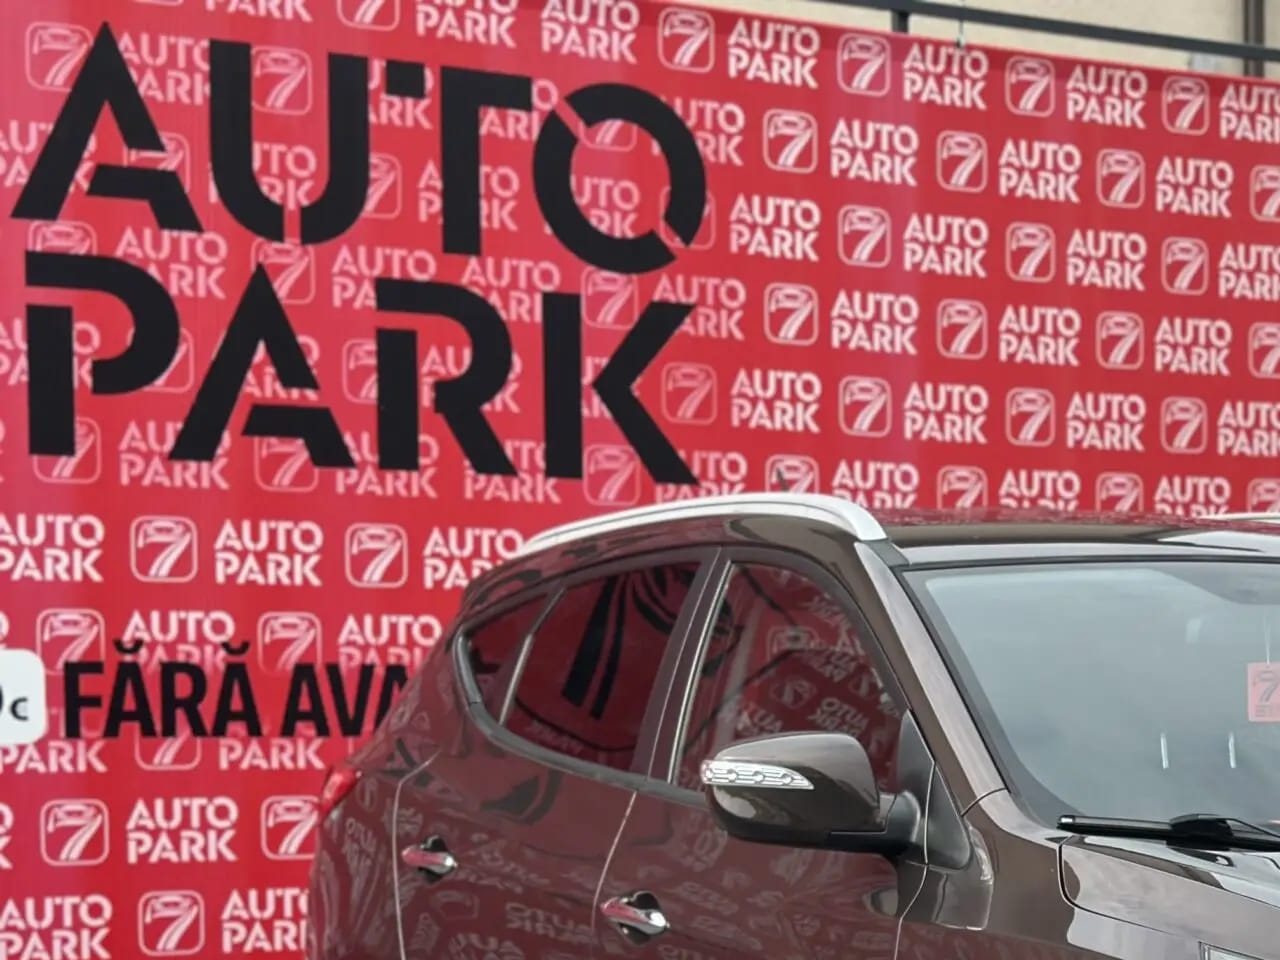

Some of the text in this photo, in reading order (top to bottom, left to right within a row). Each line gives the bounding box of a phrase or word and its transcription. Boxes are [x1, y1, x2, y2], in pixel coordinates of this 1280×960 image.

[416, 7, 516, 48] PARK
[541, 0, 639, 31] AUTO
[542, 20, 635, 62] PARK
[728, 18, 819, 56] AUTO
[729, 46, 817, 88] PARK
[903, 41, 989, 79] AUTO
[903, 70, 986, 109] PARK
[1066, 60, 1148, 99] AUTO
[1067, 91, 1144, 128] PARK
[10, 21, 707, 275] AUTO
[831, 119, 918, 155] AUTO
[831, 147, 916, 186] PARK
[999, 140, 1081, 173] AUTO
[1156, 157, 1233, 189] AUTO
[1000, 166, 1079, 203] PARK
[1156, 183, 1231, 217] PARK
[731, 195, 820, 230] AUTO
[115, 227, 228, 264] AUTO
[731, 224, 818, 261] PARK
[903, 214, 988, 247] AUTO
[1067, 230, 1146, 261] AUTO
[332, 246, 436, 282] AUTO
[461, 257, 560, 293] AUTO
[904, 241, 986, 277] PARK
[1067, 256, 1144, 290] PARK
[652, 274, 746, 309] AUTO
[831, 291, 919, 324] AUTO
[832, 318, 916, 355] PARK
[999, 306, 1081, 337] AUTO
[1155, 317, 1232, 347] AUTO
[1000, 333, 1078, 366] PARK
[1155, 343, 1229, 376] PARK
[25, 250, 699, 486] PARK
[732, 369, 821, 402] AUTO
[904, 383, 988, 414] AUTO
[732, 398, 819, 432] PARK
[1066, 392, 1146, 423] AUTO
[904, 410, 986, 443] PARK
[1067, 419, 1143, 451] PARK
[120, 453, 229, 489] PARK
[336, 470, 436, 499] PARK
[832, 461, 919, 490] AUTO
[999, 470, 1080, 498] AUTO
[1155, 477, 1230, 505] AUTO
[0, 514, 104, 547] AUTO
[214, 520, 323, 553] AUTO
[424, 528, 522, 560] AUTO
[0, 547, 102, 581] PARK
[216, 550, 321, 586] PARK
[123, 611, 235, 645] AUTO
[339, 615, 441, 647] AUTO
[63, 639, 264, 738] FĂRĂ
[219, 740, 325, 771] PARK
[127, 797, 238, 830] AUTO
[128, 829, 236, 863] PARK
[0, 895, 112, 930] AUTO
